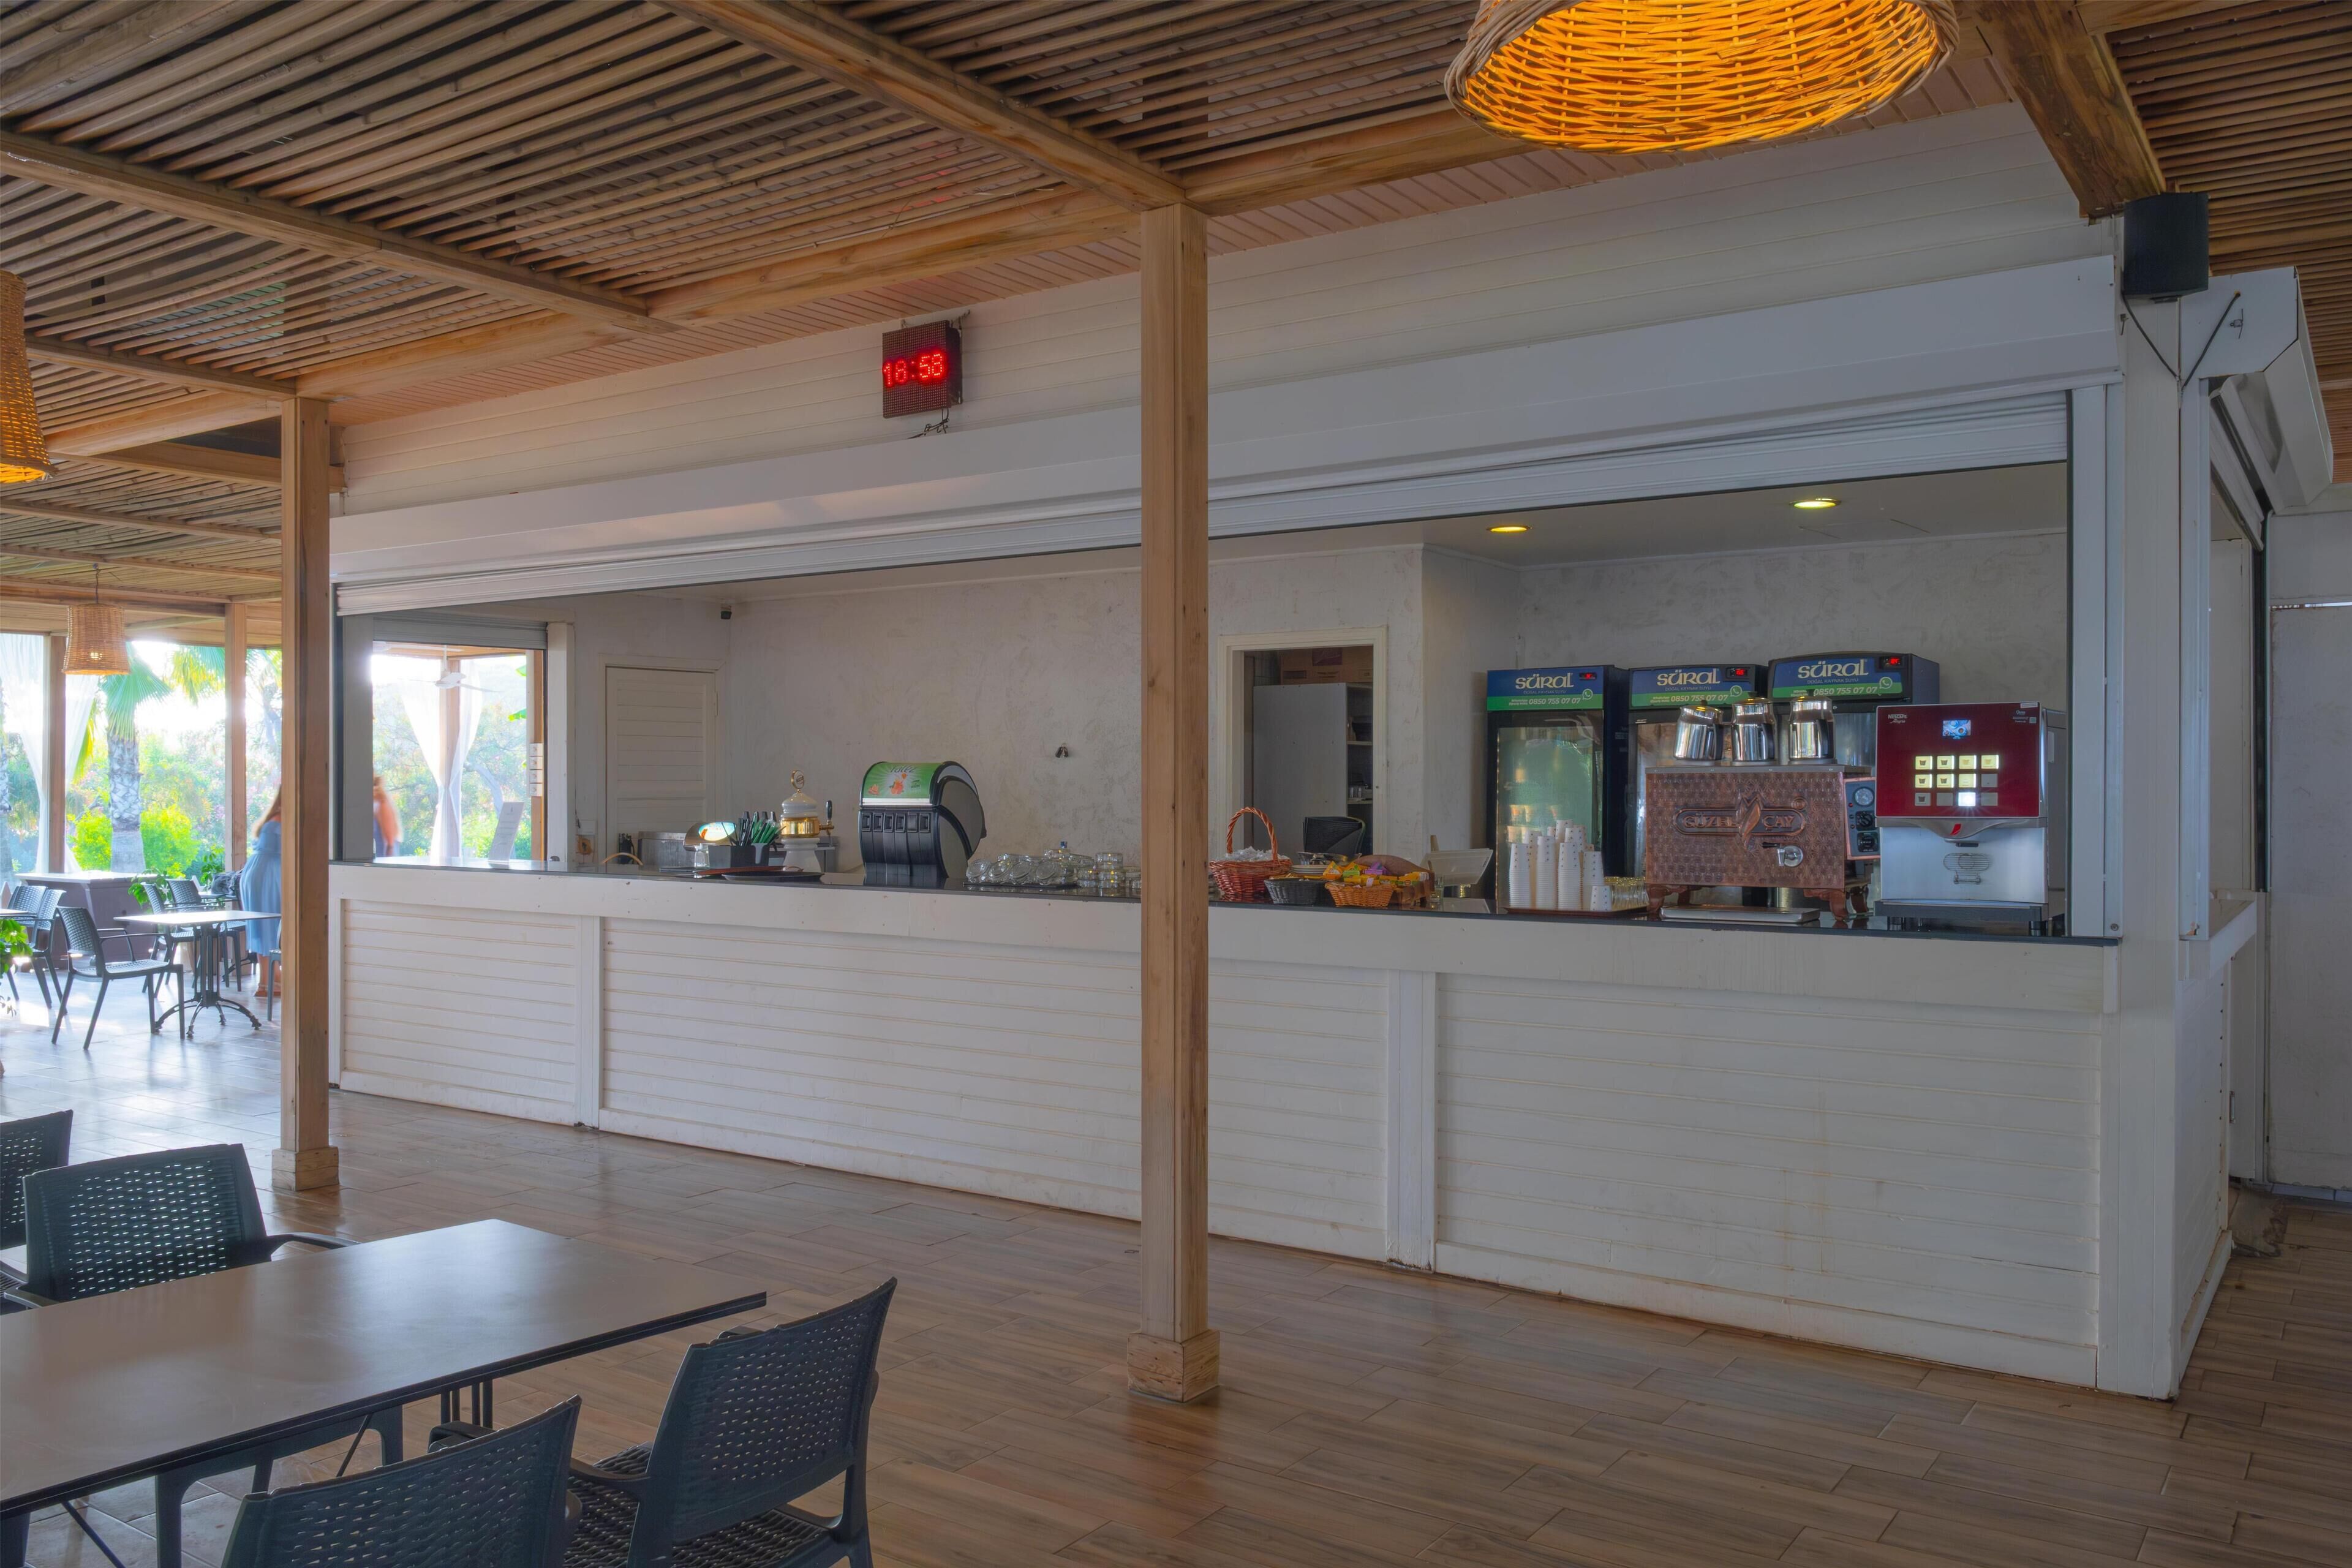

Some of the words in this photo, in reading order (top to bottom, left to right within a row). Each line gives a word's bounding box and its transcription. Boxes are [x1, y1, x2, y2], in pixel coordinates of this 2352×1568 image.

[883, 353, 943, 385] 18:58
[1683, 813, 1738, 828] GÜZEL
[1763, 815, 1795, 831] ÇAY
